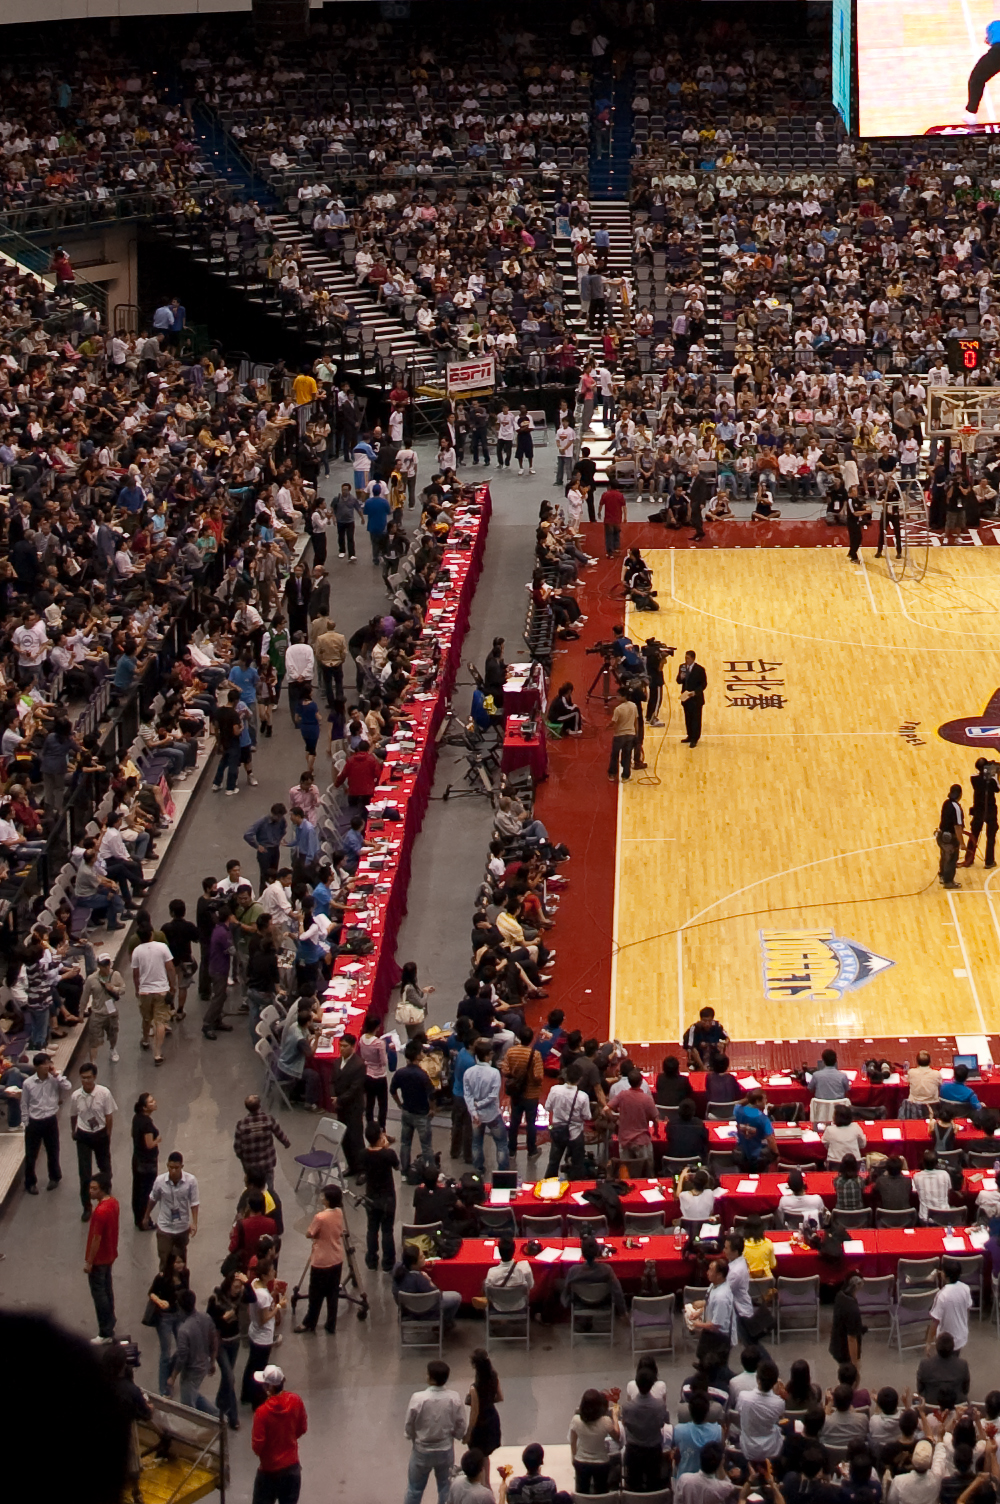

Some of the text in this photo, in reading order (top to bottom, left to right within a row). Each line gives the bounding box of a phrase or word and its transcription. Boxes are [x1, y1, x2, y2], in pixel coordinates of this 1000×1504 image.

[449, 362, 492, 383] ESPN
[964, 350, 977, 368] 0
[722, 658, 788, 710] 台北賽
[898, 720, 927, 746] TAIPEI
[761, 929, 842, 1000] NUGGETS
[831, 942, 857, 988] DENVER
